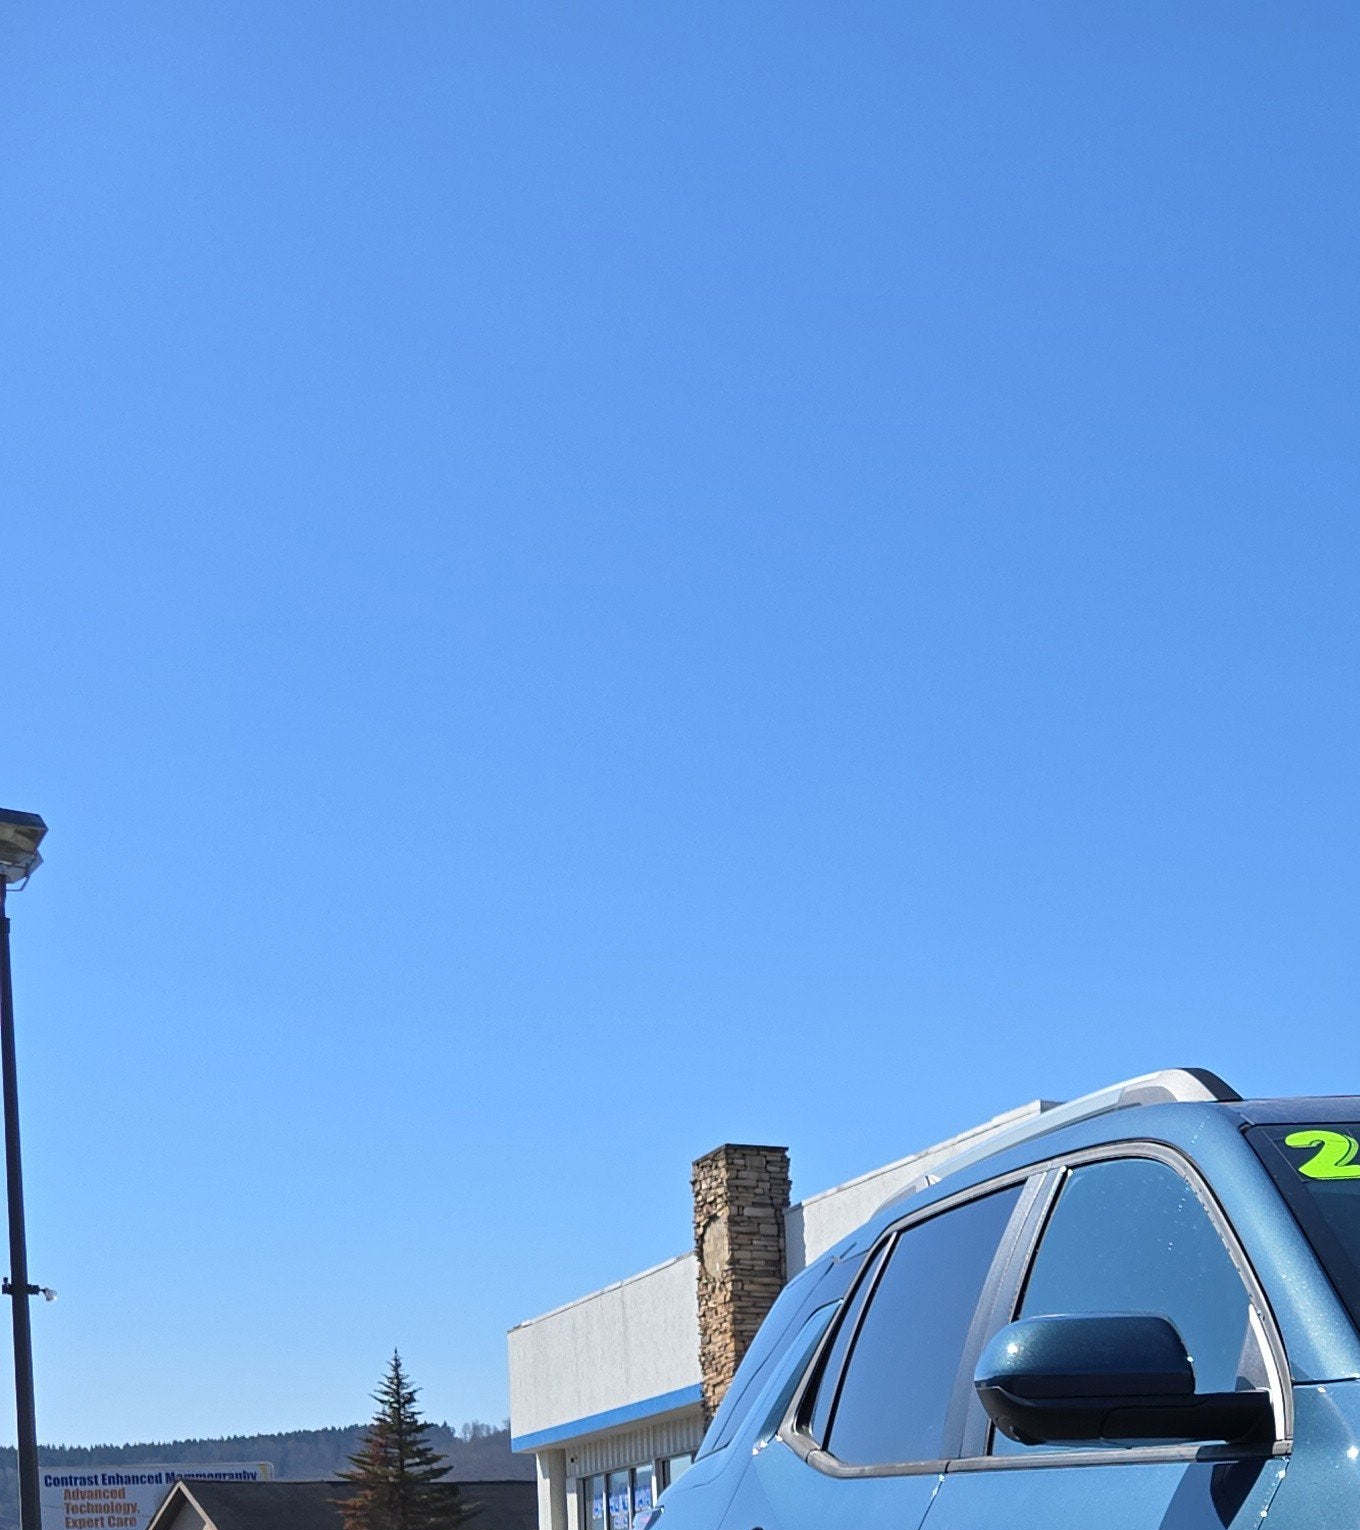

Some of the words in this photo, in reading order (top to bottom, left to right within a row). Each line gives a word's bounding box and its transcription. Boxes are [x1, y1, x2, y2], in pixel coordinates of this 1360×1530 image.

[44, 1473, 99, 1488] Contrast
[101, 1471, 163, 1486] Enhanced
[64, 1487, 126, 1501] Advanced
[65, 1516, 105, 1530] Expert
[108, 1515, 138, 1528] Care
